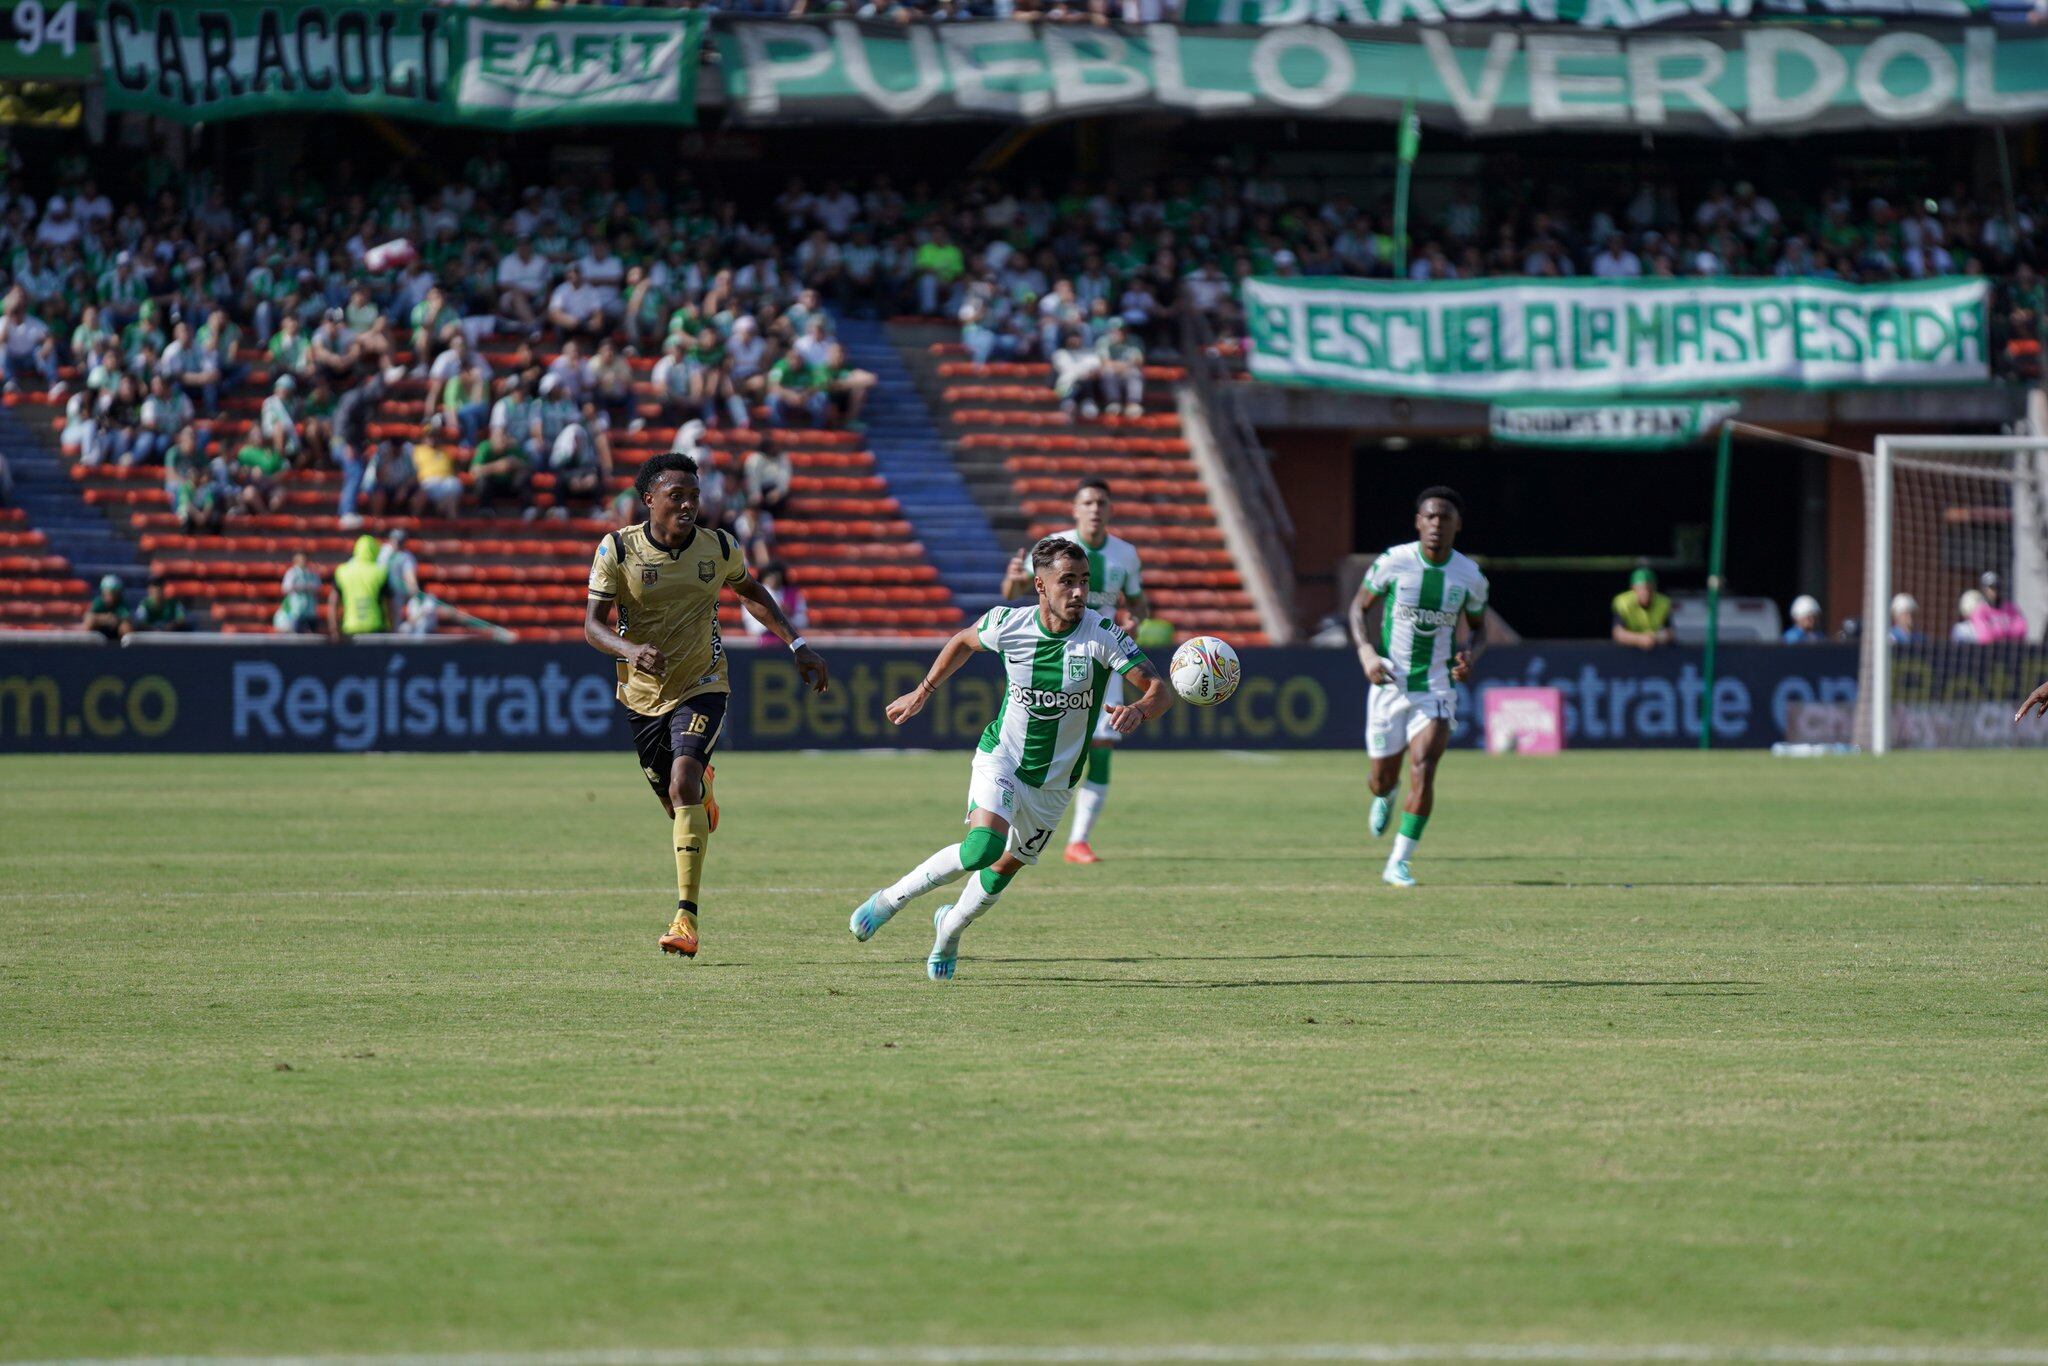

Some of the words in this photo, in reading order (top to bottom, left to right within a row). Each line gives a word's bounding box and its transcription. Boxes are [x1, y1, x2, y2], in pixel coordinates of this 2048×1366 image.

[13, 0, 77, 56] 94
[480, 31, 671, 76] EAFIT
[736, 20, 1355, 116] PUEBLO
[1307, 300, 1557, 375] ESCUELA
[231, 653, 616, 750] Regístrate
[1008, 683, 1095, 709] OSTOBON
[1201, 673, 1211, 697] GOLTY
[688, 712, 710, 734] 16
[1025, 828, 1053, 853] 21
